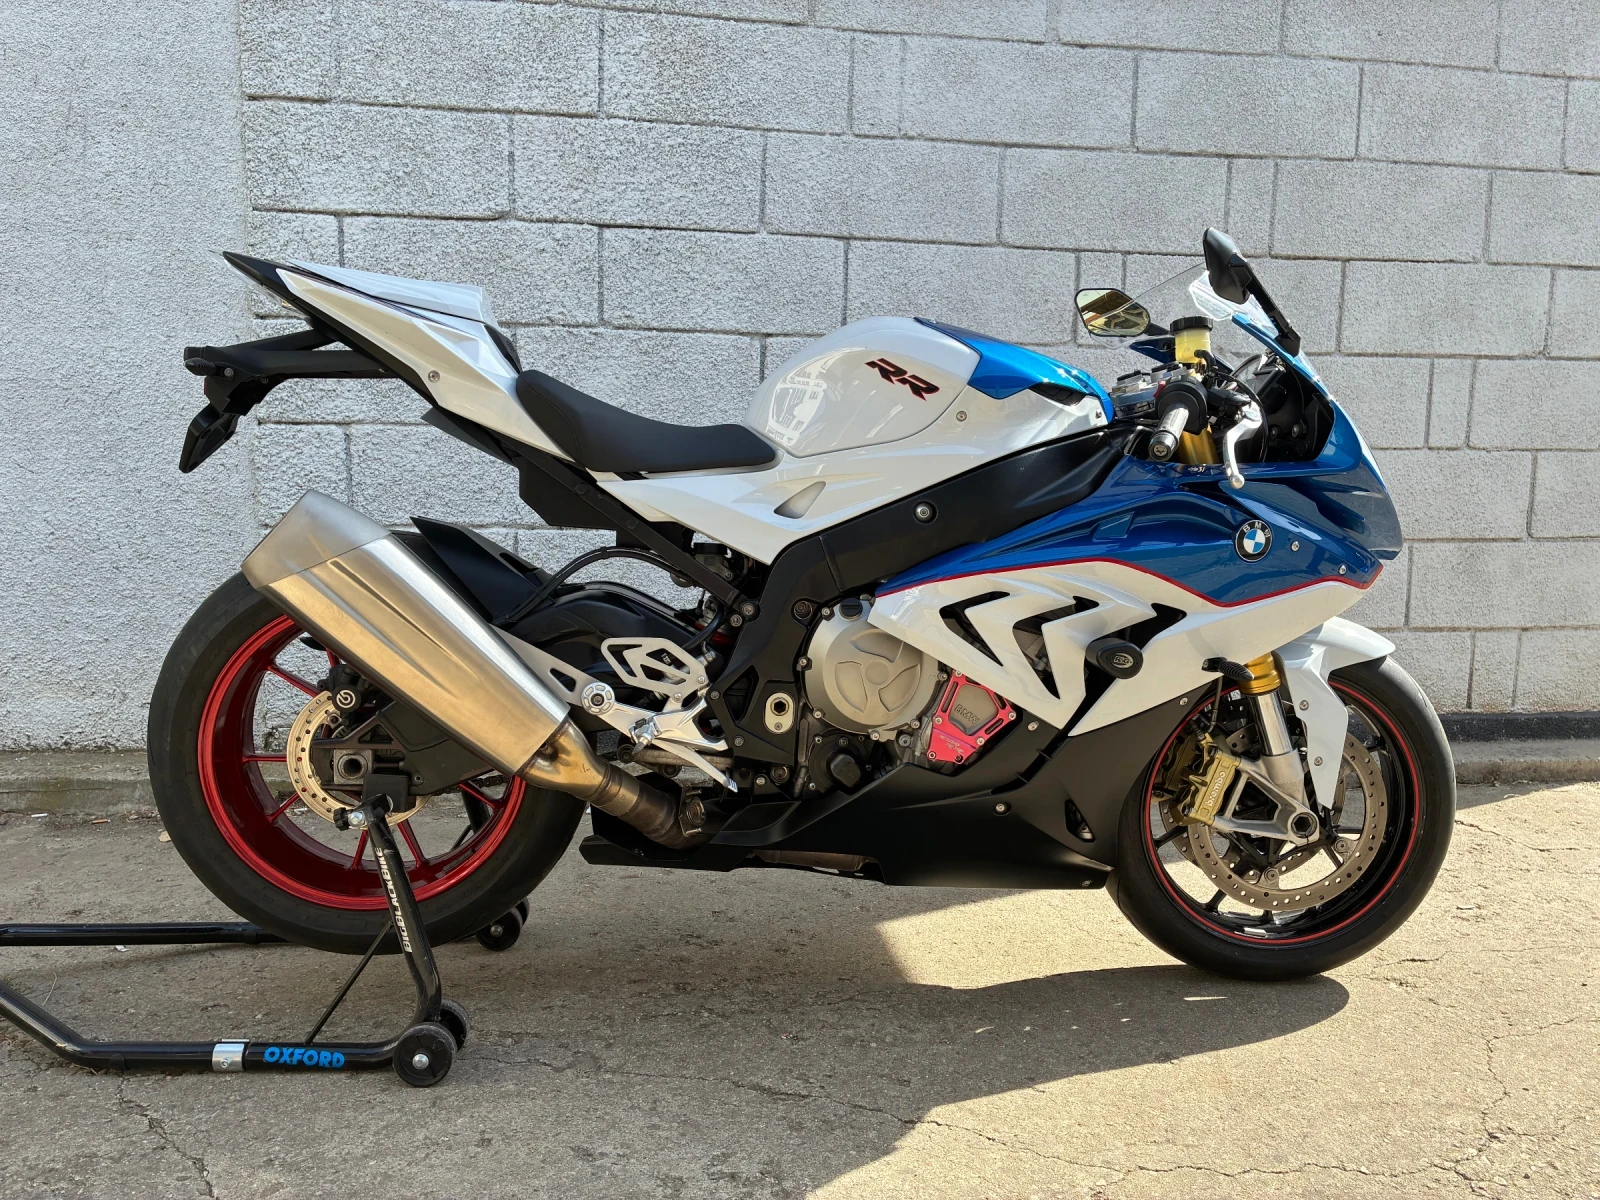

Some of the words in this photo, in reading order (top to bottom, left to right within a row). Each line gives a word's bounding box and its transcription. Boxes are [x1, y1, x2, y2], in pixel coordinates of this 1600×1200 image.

[864, 358, 940, 402] RR
[1242, 521, 1270, 538] BMW
[954, 703, 980, 725] BMW
[1205, 771, 1226, 807] brembo
[263, 1046, 345, 1069] OXFORD
